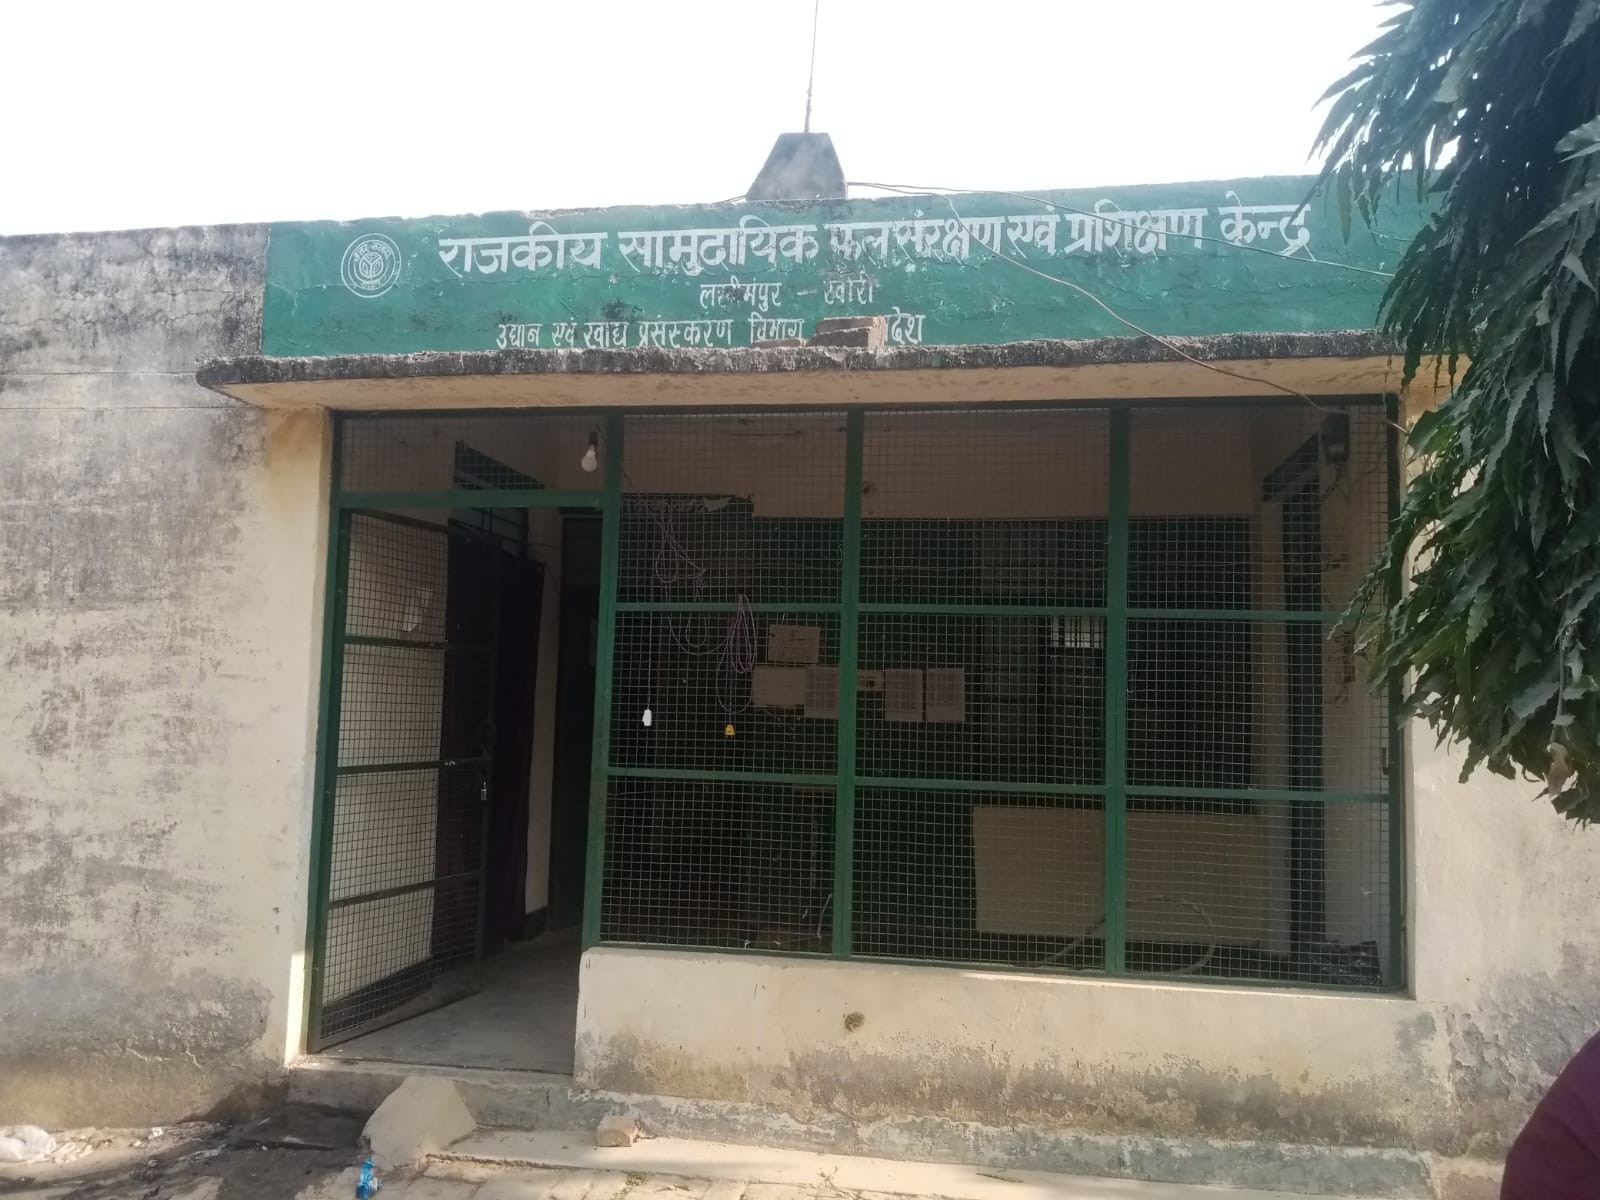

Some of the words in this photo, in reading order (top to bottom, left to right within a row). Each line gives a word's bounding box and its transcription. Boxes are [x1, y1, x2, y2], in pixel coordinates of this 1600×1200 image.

[438, 221, 608, 278] राजकीय
[617, 215, 819, 277] सामुदायिक
[496, 323, 543, 350] उद्यान
